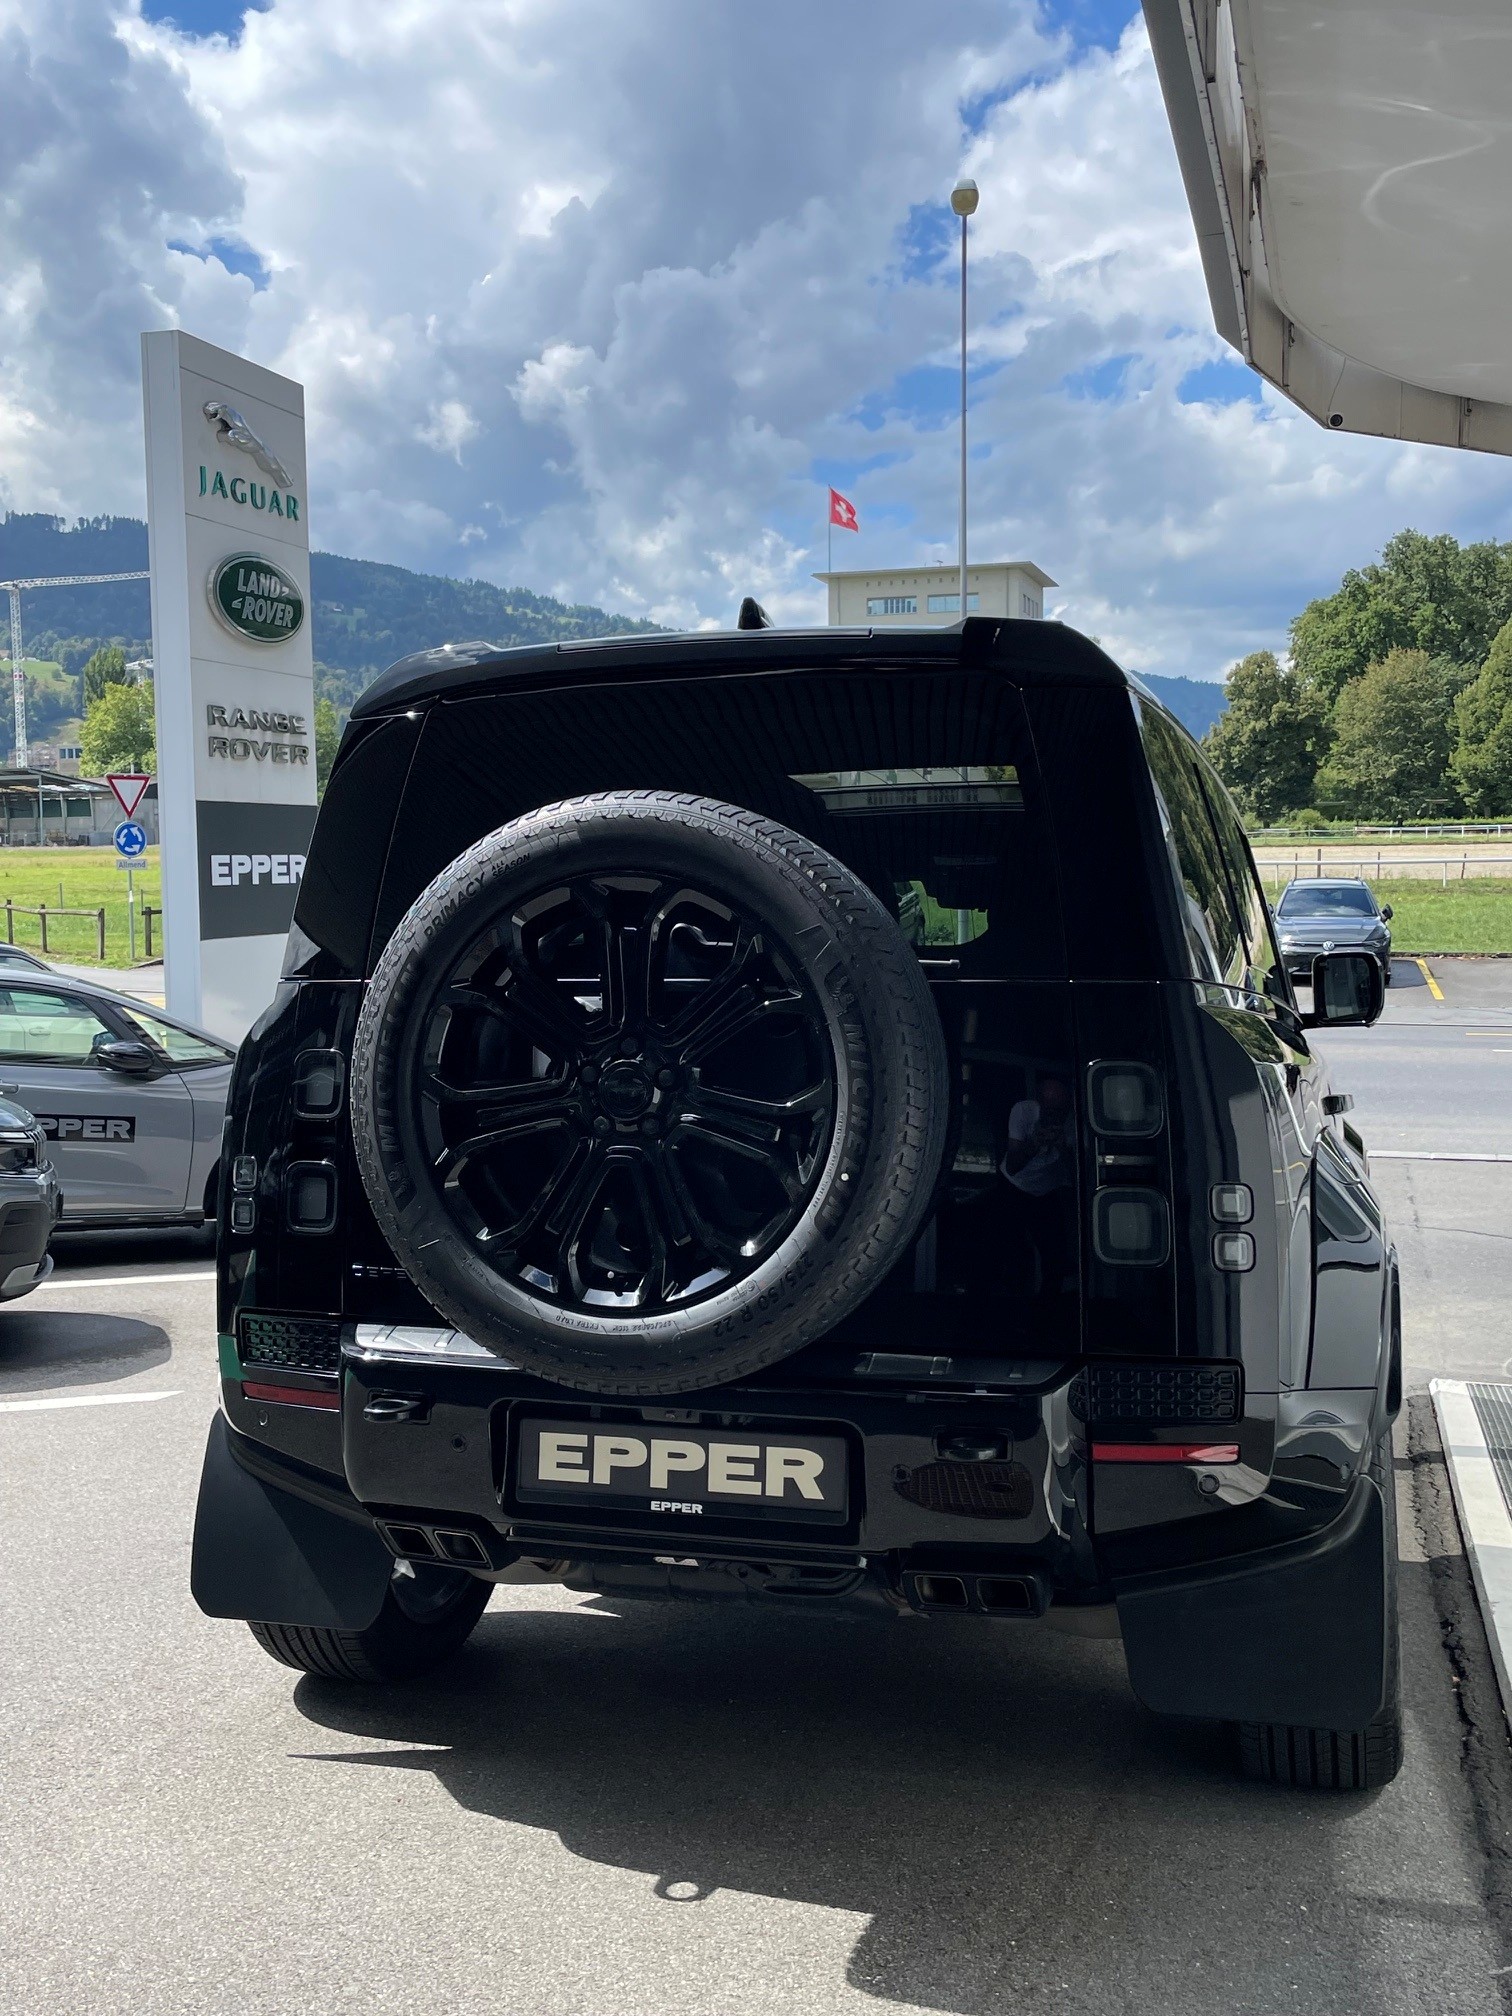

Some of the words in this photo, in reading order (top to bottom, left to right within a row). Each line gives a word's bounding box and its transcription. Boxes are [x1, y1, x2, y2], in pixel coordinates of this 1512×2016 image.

[199, 465, 300, 521] JAGUAR
[237, 568, 281, 599] LAND
[241, 596, 294, 628] ROVER
[207, 704, 308, 736] RANGE
[208, 736, 309, 765] ROVER
[118, 861, 146, 869] Allmend
[211, 855, 307, 886] EPPER
[490, 860, 505, 872] ALL
[492, 853, 531, 879] SEASON
[424, 872, 485, 940] PRIMACY
[34, 1117, 131, 1139] PPER
[538, 1432, 824, 1500] EPPER
[650, 1500, 703, 1514] EPPER
